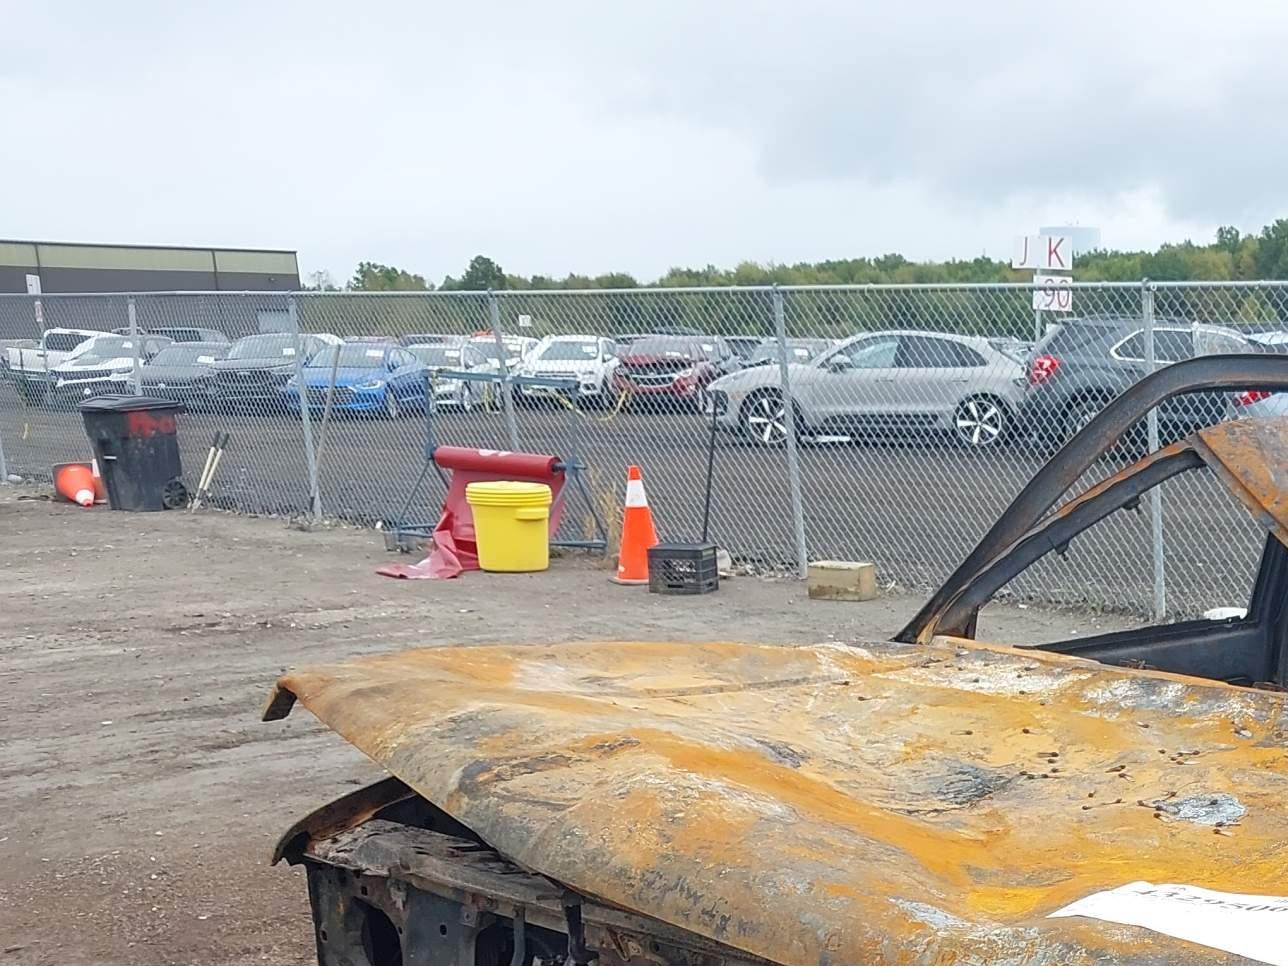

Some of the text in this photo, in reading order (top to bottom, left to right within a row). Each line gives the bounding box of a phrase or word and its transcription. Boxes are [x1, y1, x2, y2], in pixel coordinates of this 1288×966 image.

[1019, 236, 1065, 268] J K
[1044, 278, 1070, 309] 90
